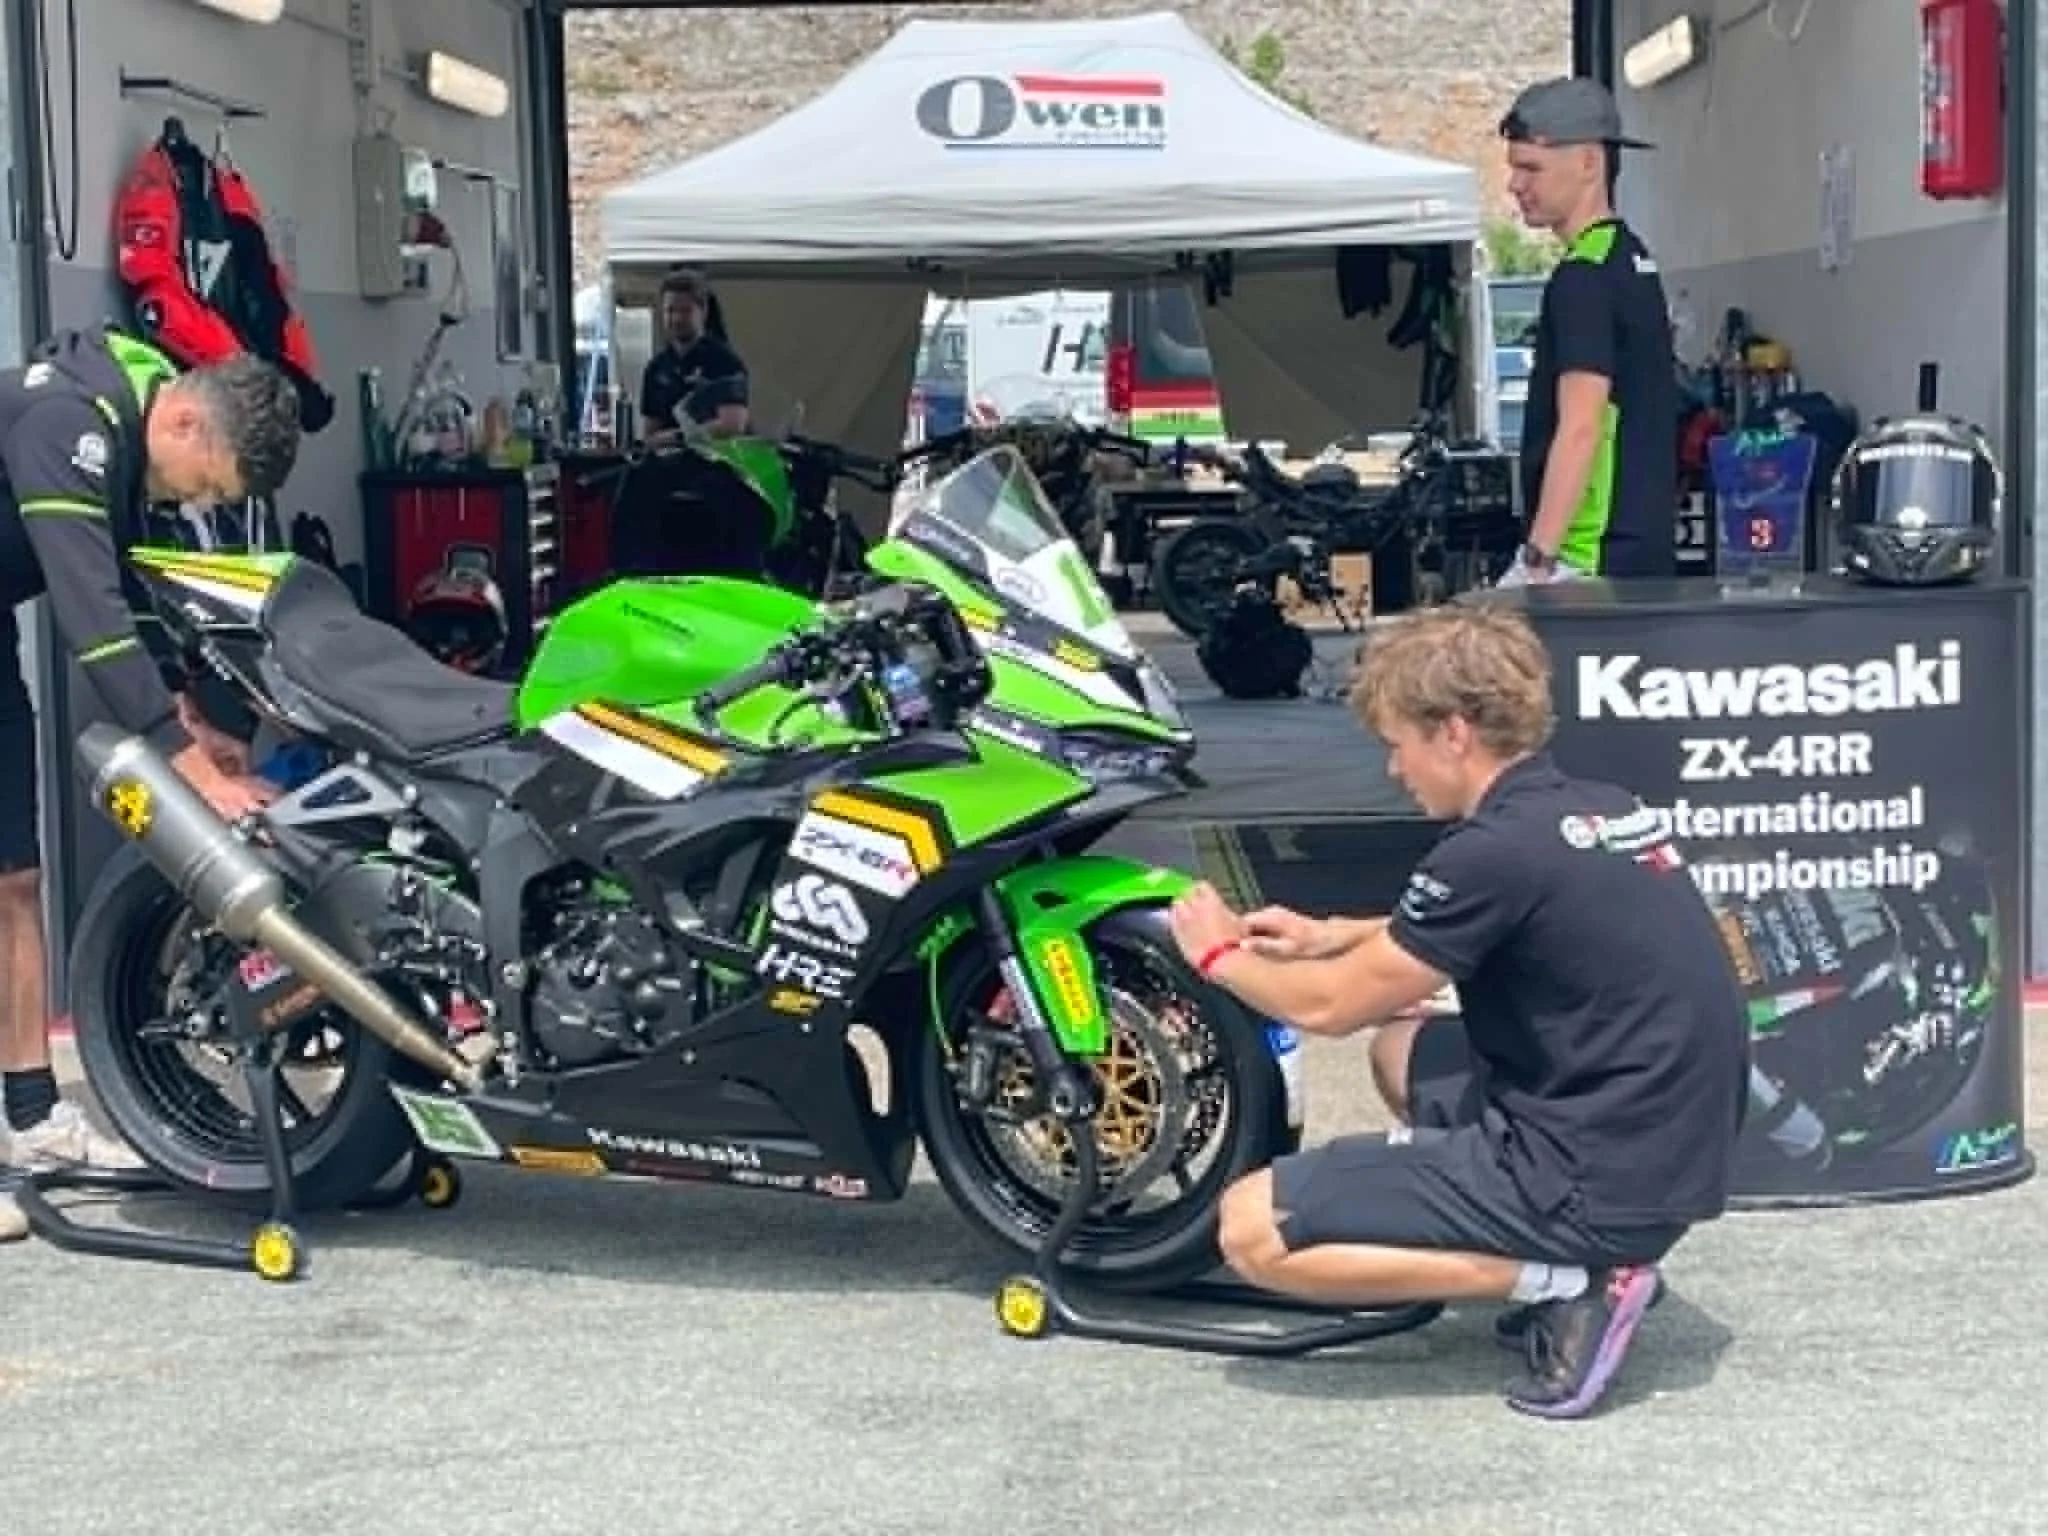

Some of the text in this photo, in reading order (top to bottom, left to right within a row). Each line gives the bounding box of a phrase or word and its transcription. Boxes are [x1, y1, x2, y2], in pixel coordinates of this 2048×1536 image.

[916, 75, 1164, 140] Owen
[1750, 518, 1772, 546] 3
[1577, 640, 1961, 720] Kawasaki
[1679, 732, 1873, 781] ZX-4RR
